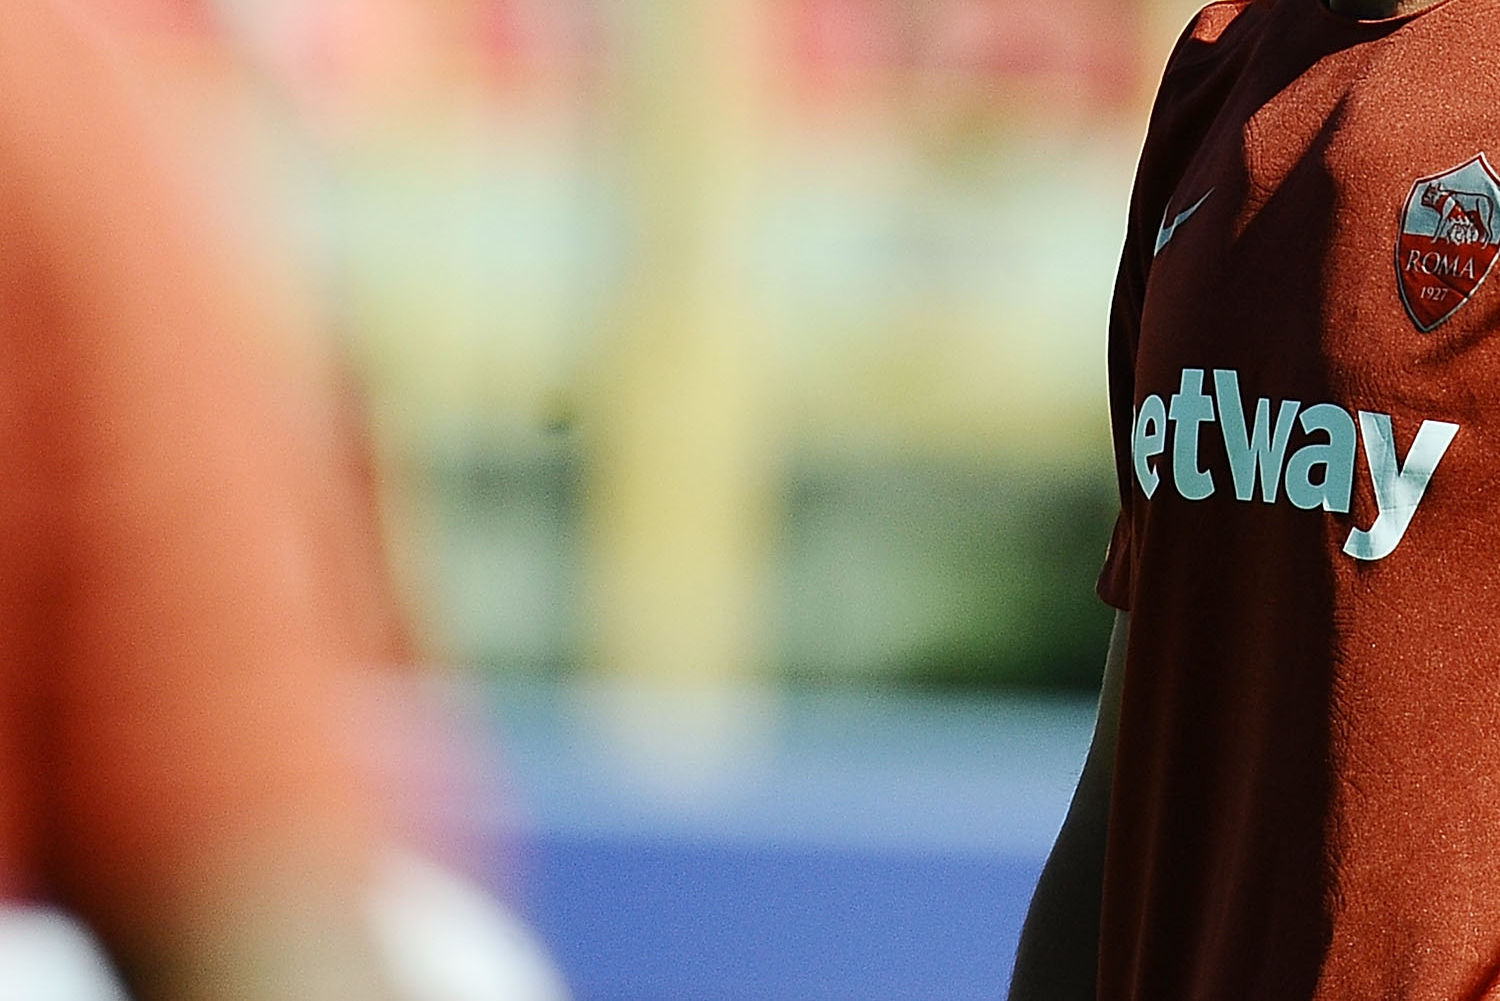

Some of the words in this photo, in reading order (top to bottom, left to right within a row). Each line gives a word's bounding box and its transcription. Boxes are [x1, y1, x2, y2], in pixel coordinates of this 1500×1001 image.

[1405, 250, 1475, 279] ROMA
[1420, 286, 1449, 301] 1927
[1132, 368, 1459, 561] etway
